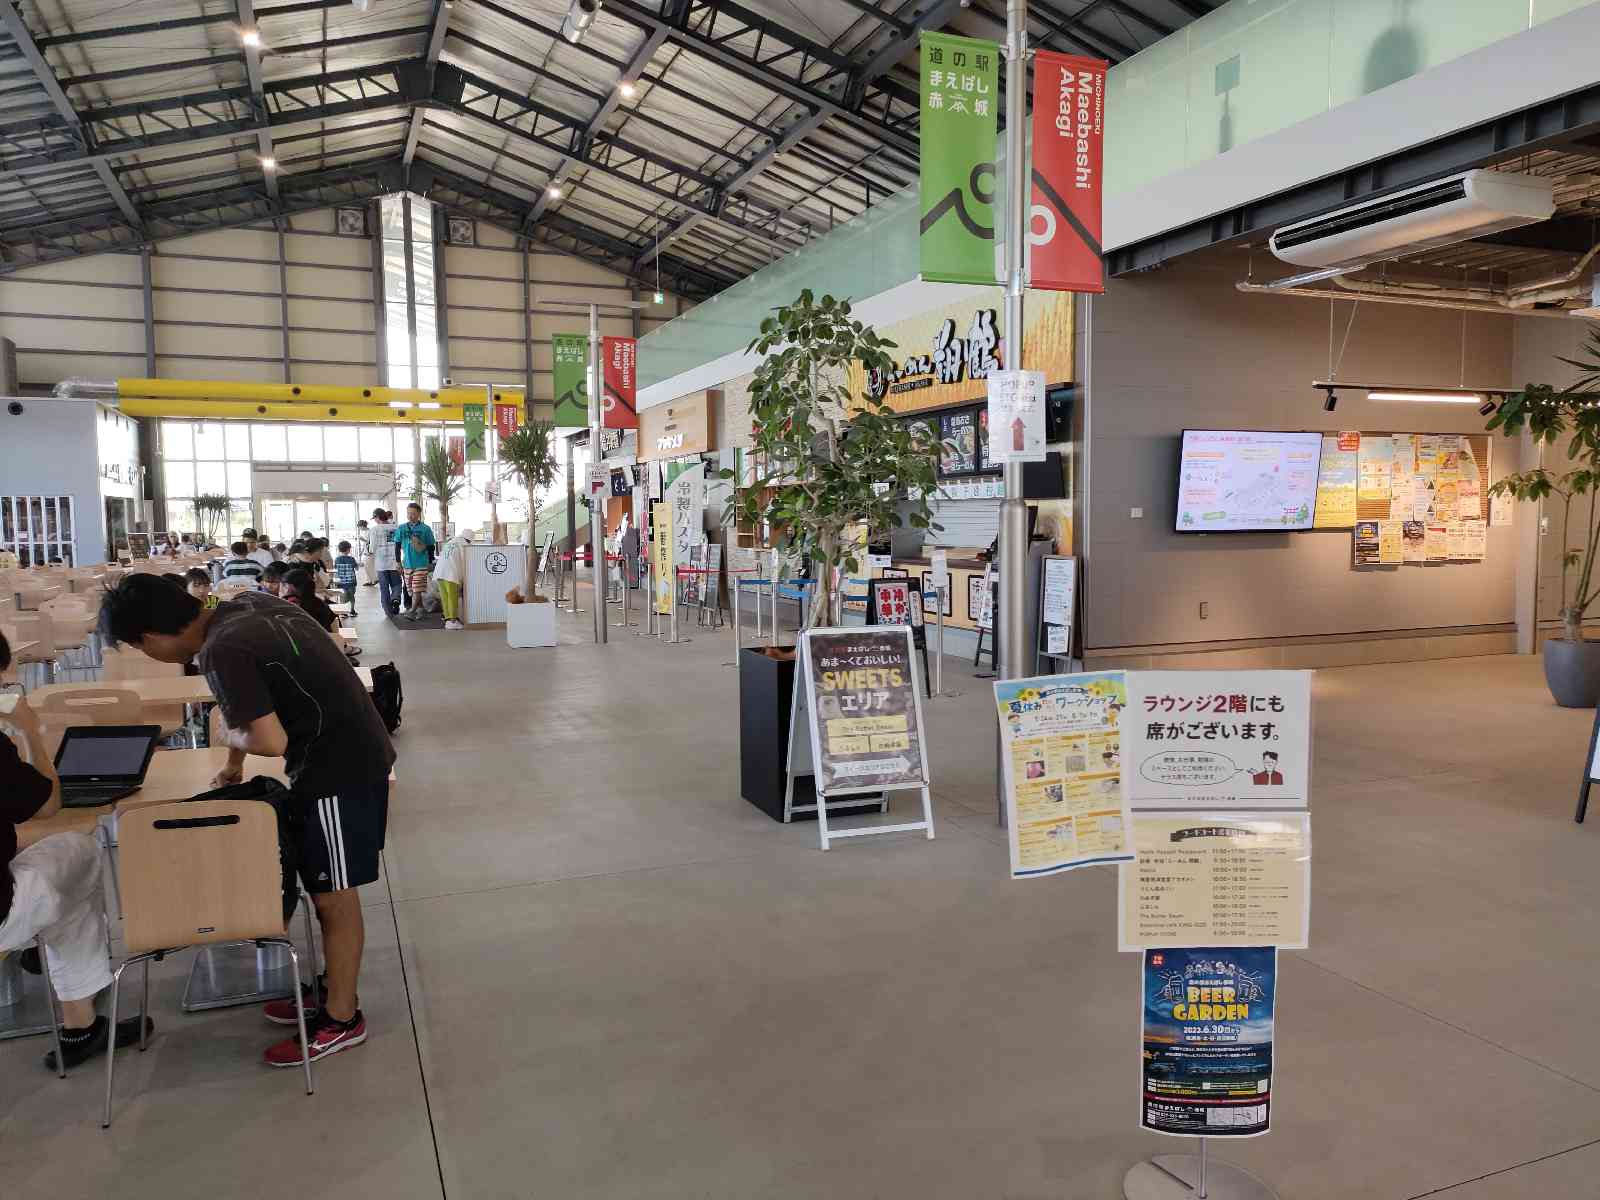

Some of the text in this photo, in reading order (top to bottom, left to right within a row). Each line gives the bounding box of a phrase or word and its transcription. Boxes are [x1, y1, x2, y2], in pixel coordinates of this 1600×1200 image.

[929, 47, 990, 72] 道の駅
[929, 70, 989, 93] まえばし
[1056, 66, 1075, 138] Akagi
[1075, 71, 1093, 189] Maebashi
[822, 668, 903, 690] SWEETS
[841, 691, 889, 711] エリア
[1143, 694, 1285, 713] ラウンジ2階にも
[1146, 722, 1280, 741] 席がございます。
[1187, 986, 1236, 1003] BEER
[1172, 1003, 1249, 1021] GARDEN
